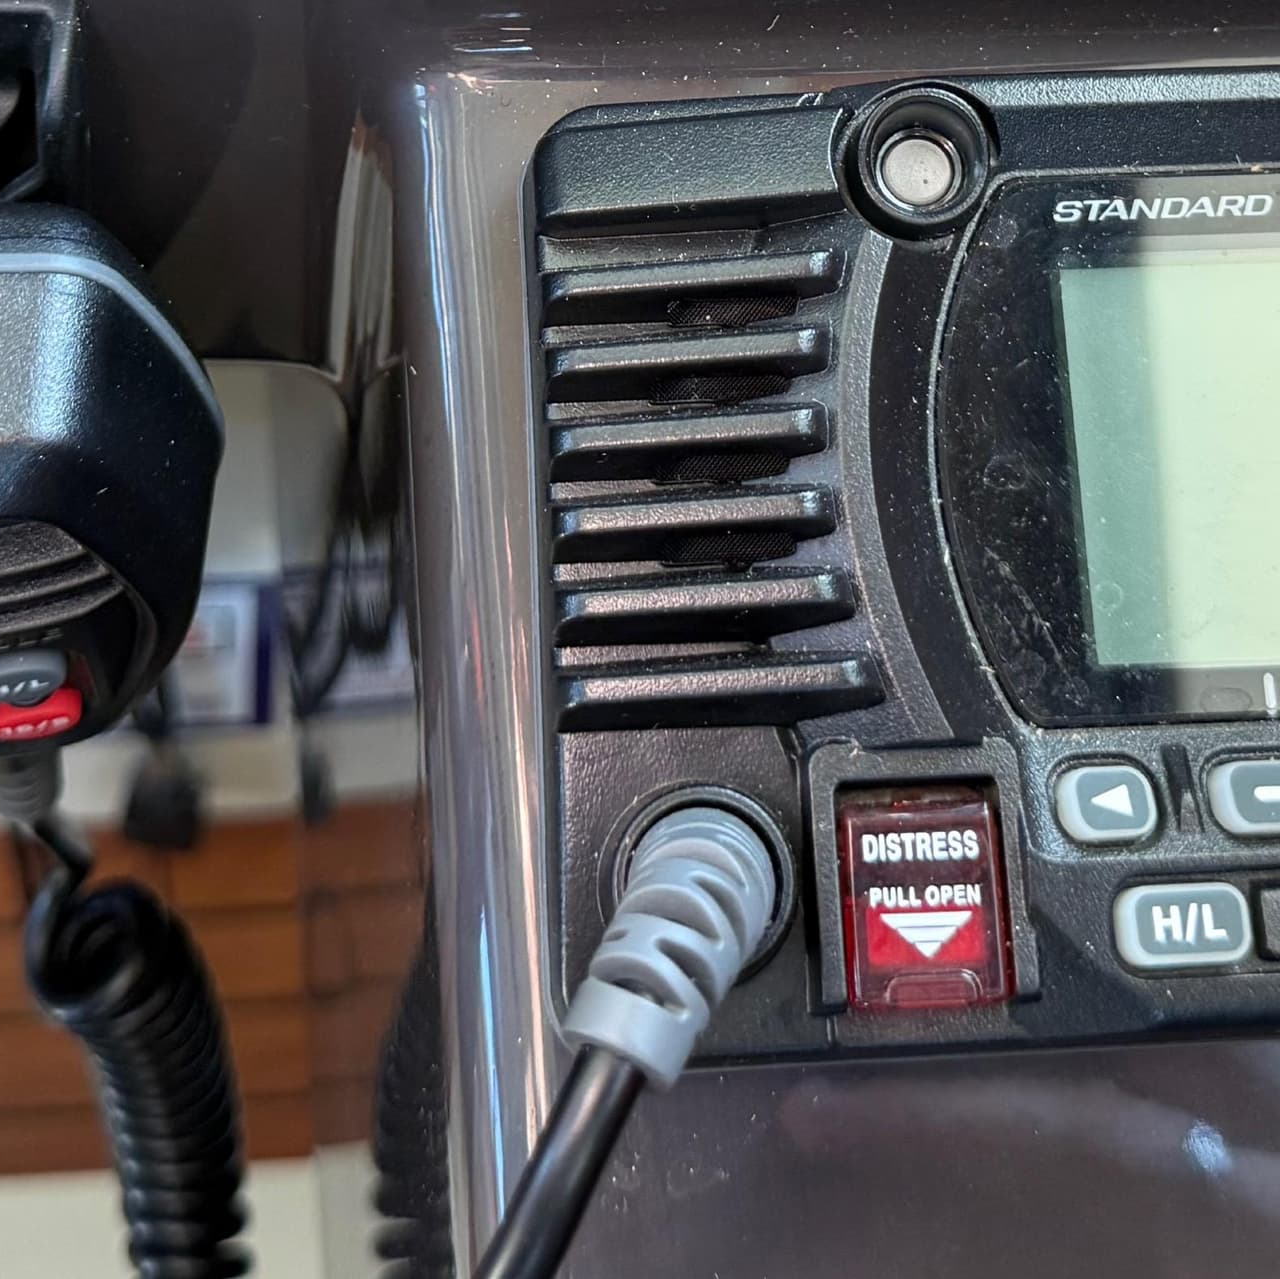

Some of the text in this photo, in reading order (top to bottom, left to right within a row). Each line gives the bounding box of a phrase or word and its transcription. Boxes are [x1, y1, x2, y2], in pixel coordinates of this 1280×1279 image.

[1053, 195, 1273, 225] STANDARD
[862, 830, 979, 863] DISTRESS
[869, 883, 981, 907] PULL OPEN
[1151, 904, 1228, 946] H/L
